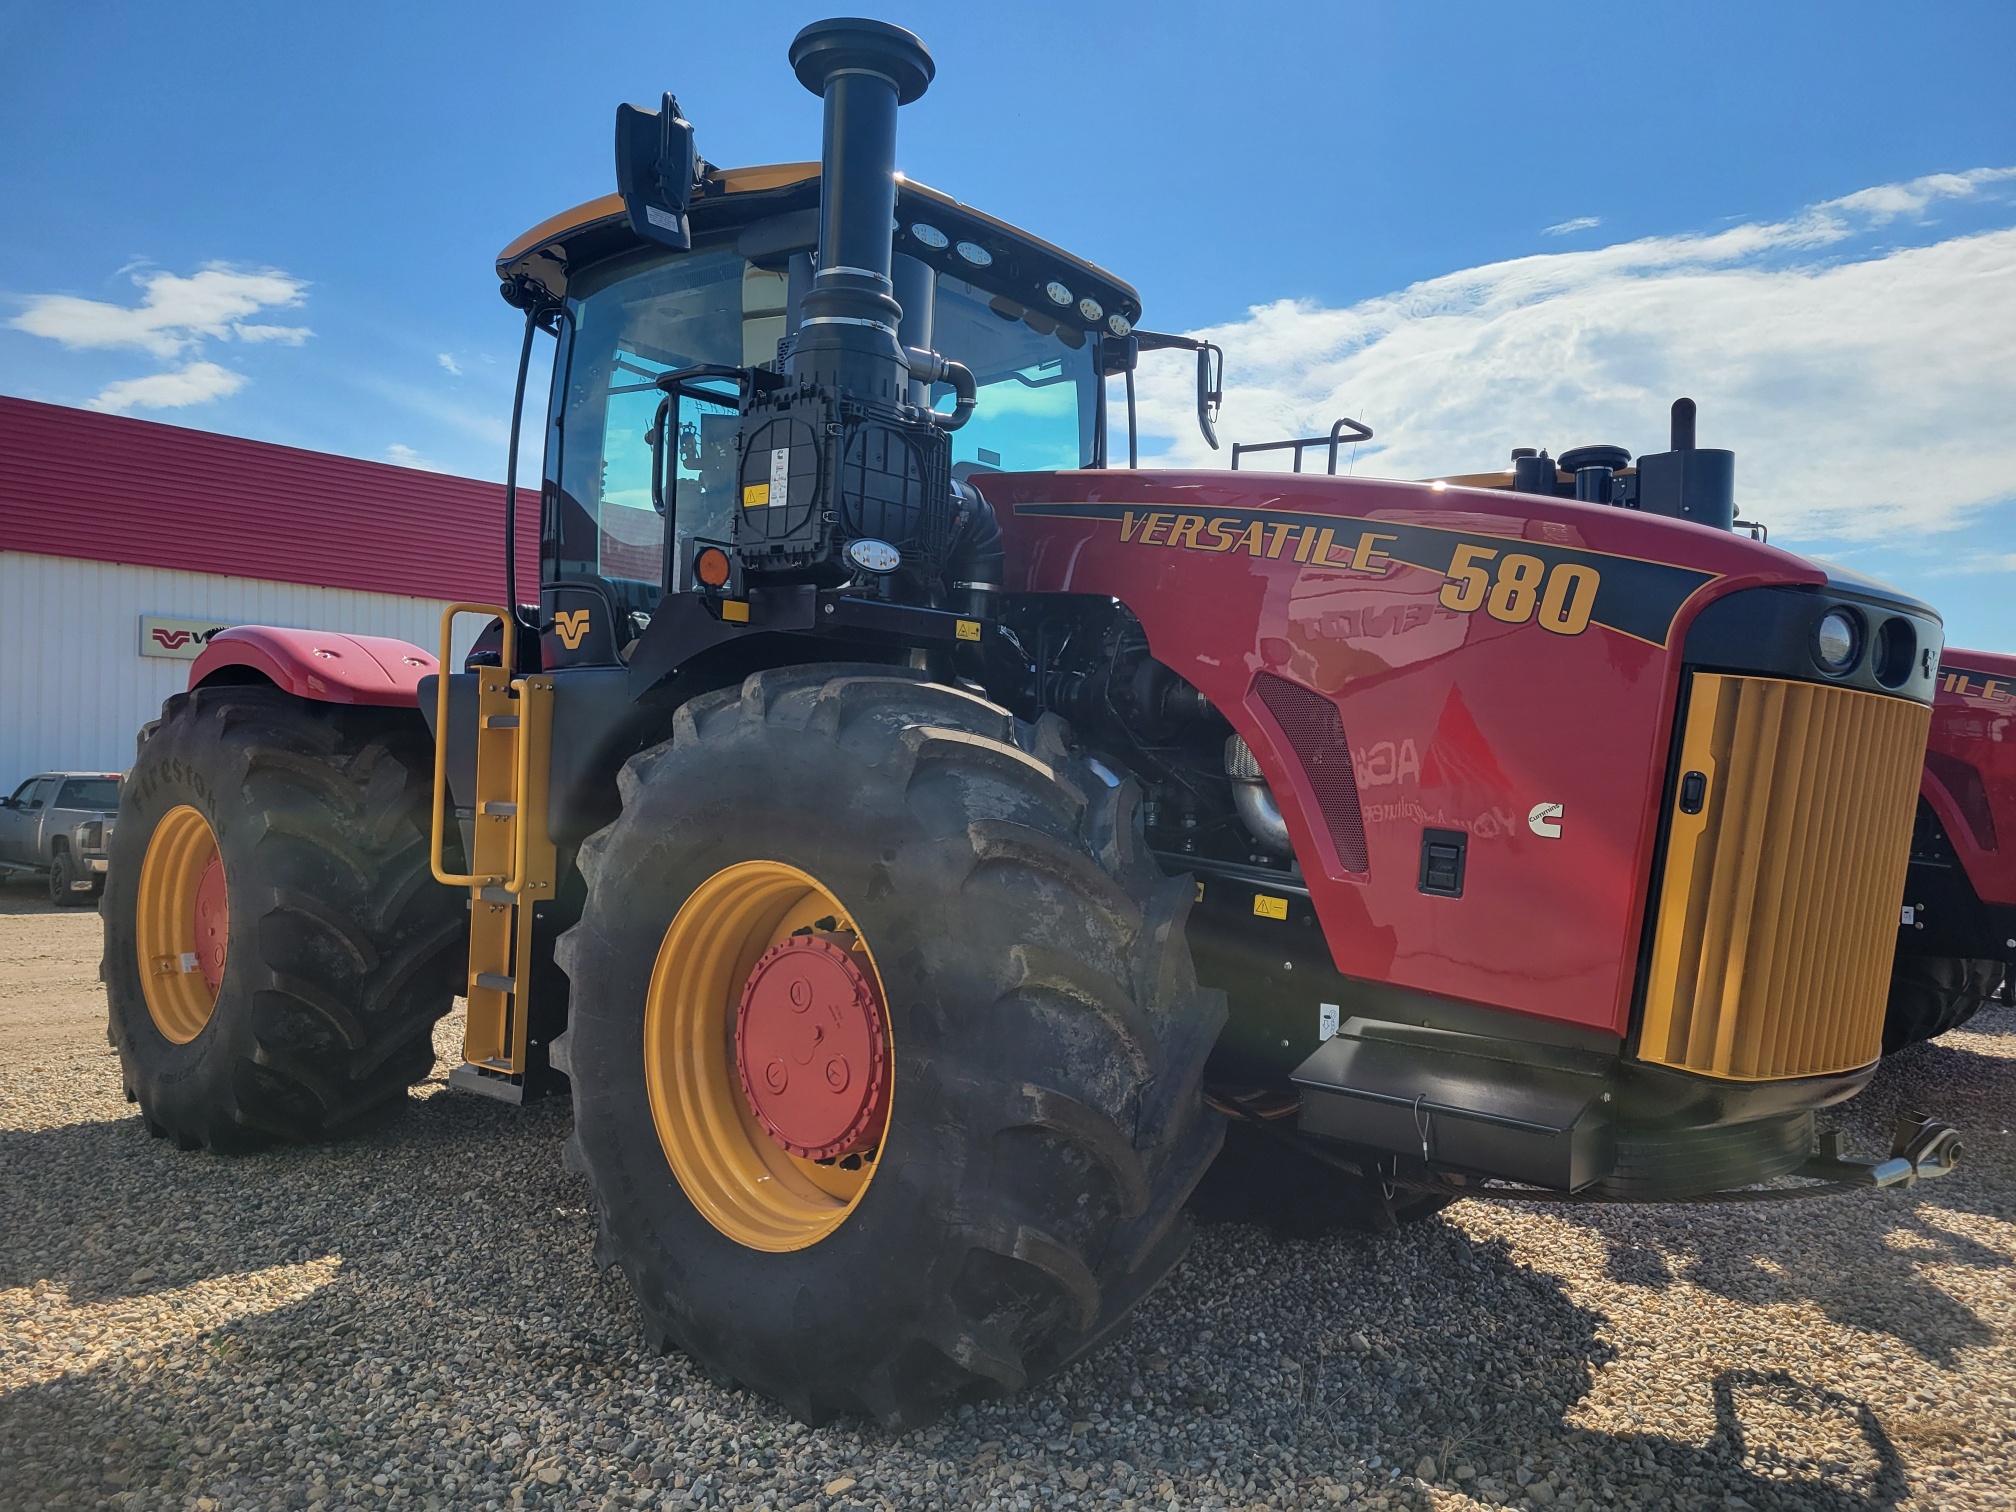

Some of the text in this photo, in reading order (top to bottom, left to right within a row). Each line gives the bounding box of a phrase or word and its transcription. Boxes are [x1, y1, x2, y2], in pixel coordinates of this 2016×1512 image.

[1118, 510, 1399, 575] VERSATILE
[1438, 543, 1601, 636] 580
[1529, 803, 1561, 823] Cummins
